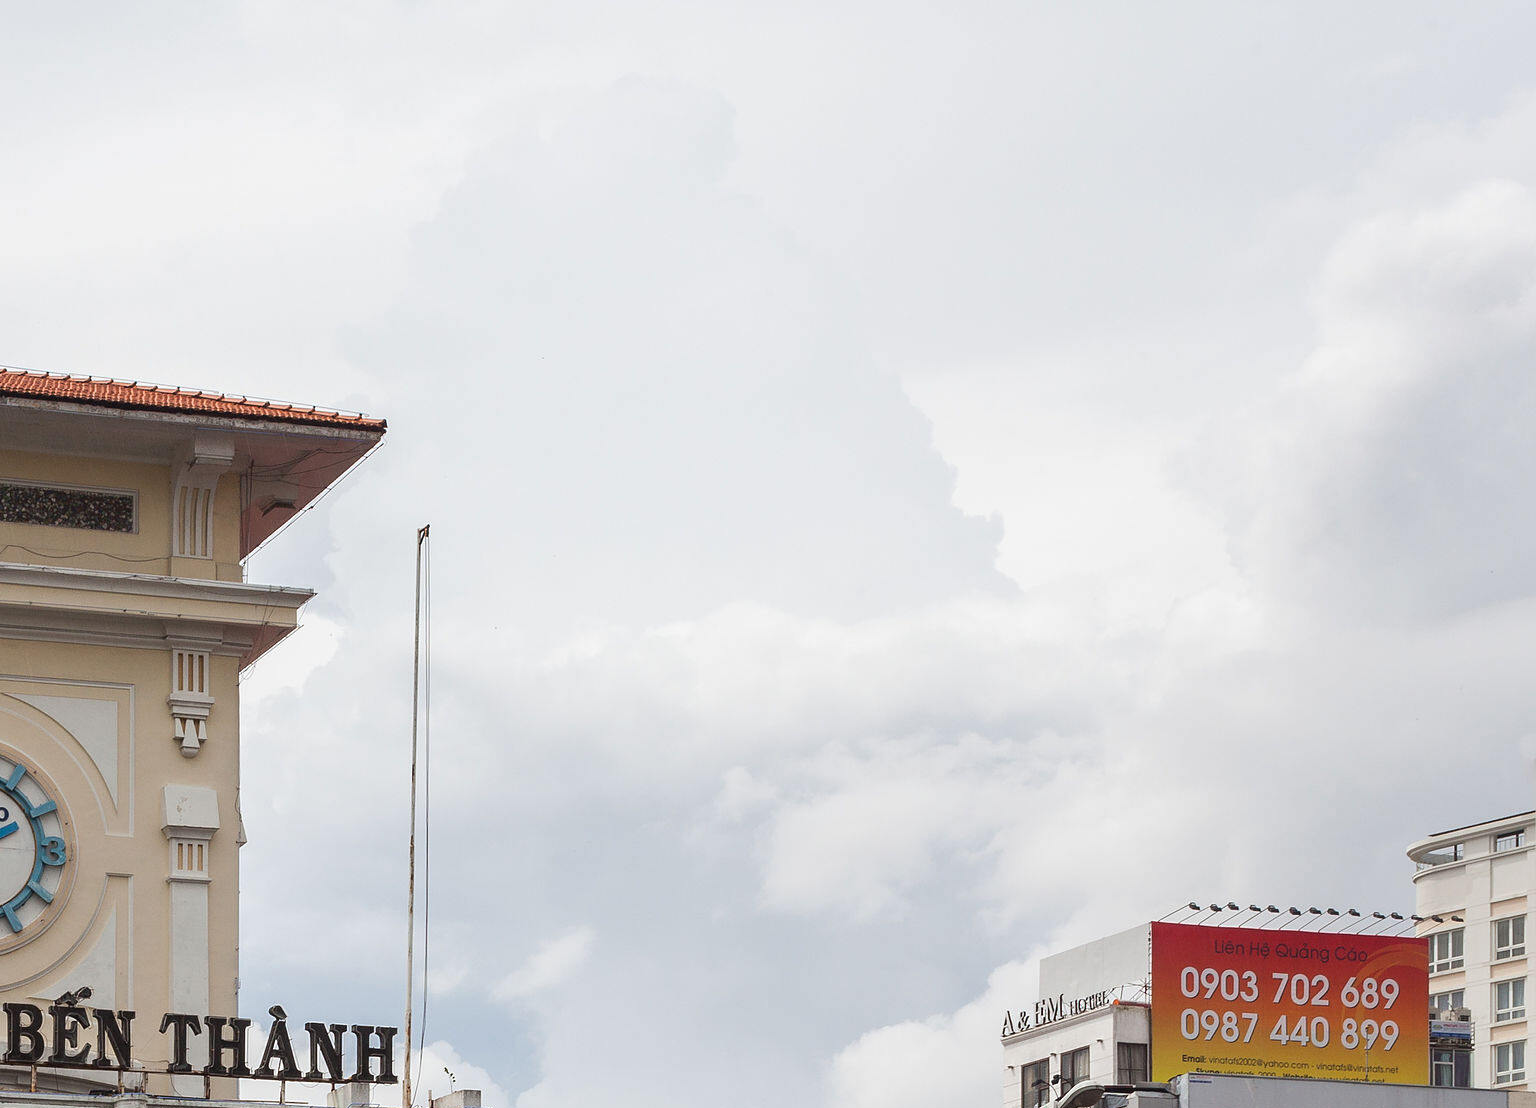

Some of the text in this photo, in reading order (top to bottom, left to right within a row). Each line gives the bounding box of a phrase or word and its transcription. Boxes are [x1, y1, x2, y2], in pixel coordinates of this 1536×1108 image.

[40, 836, 67, 866] 3
[1214, 939, 1368, 963] Liên Hệ Quảng Cáo
[1180, 966, 1400, 1010] 0903 702 689
[3, 986, 135, 1068] BẾN
[159, 1005, 398, 1084] THÀNH
[1002, 1010, 1015, 1037] A
[1018, 1011, 1030, 1032] &
[1035, 993, 1067, 1027] EM
[1180, 1008, 1259, 1043] 0987
[1269, 1015, 1330, 1048] 440
[1340, 1018, 1400, 1051] 899
[1182, 1054, 1207, 1064] Email:
